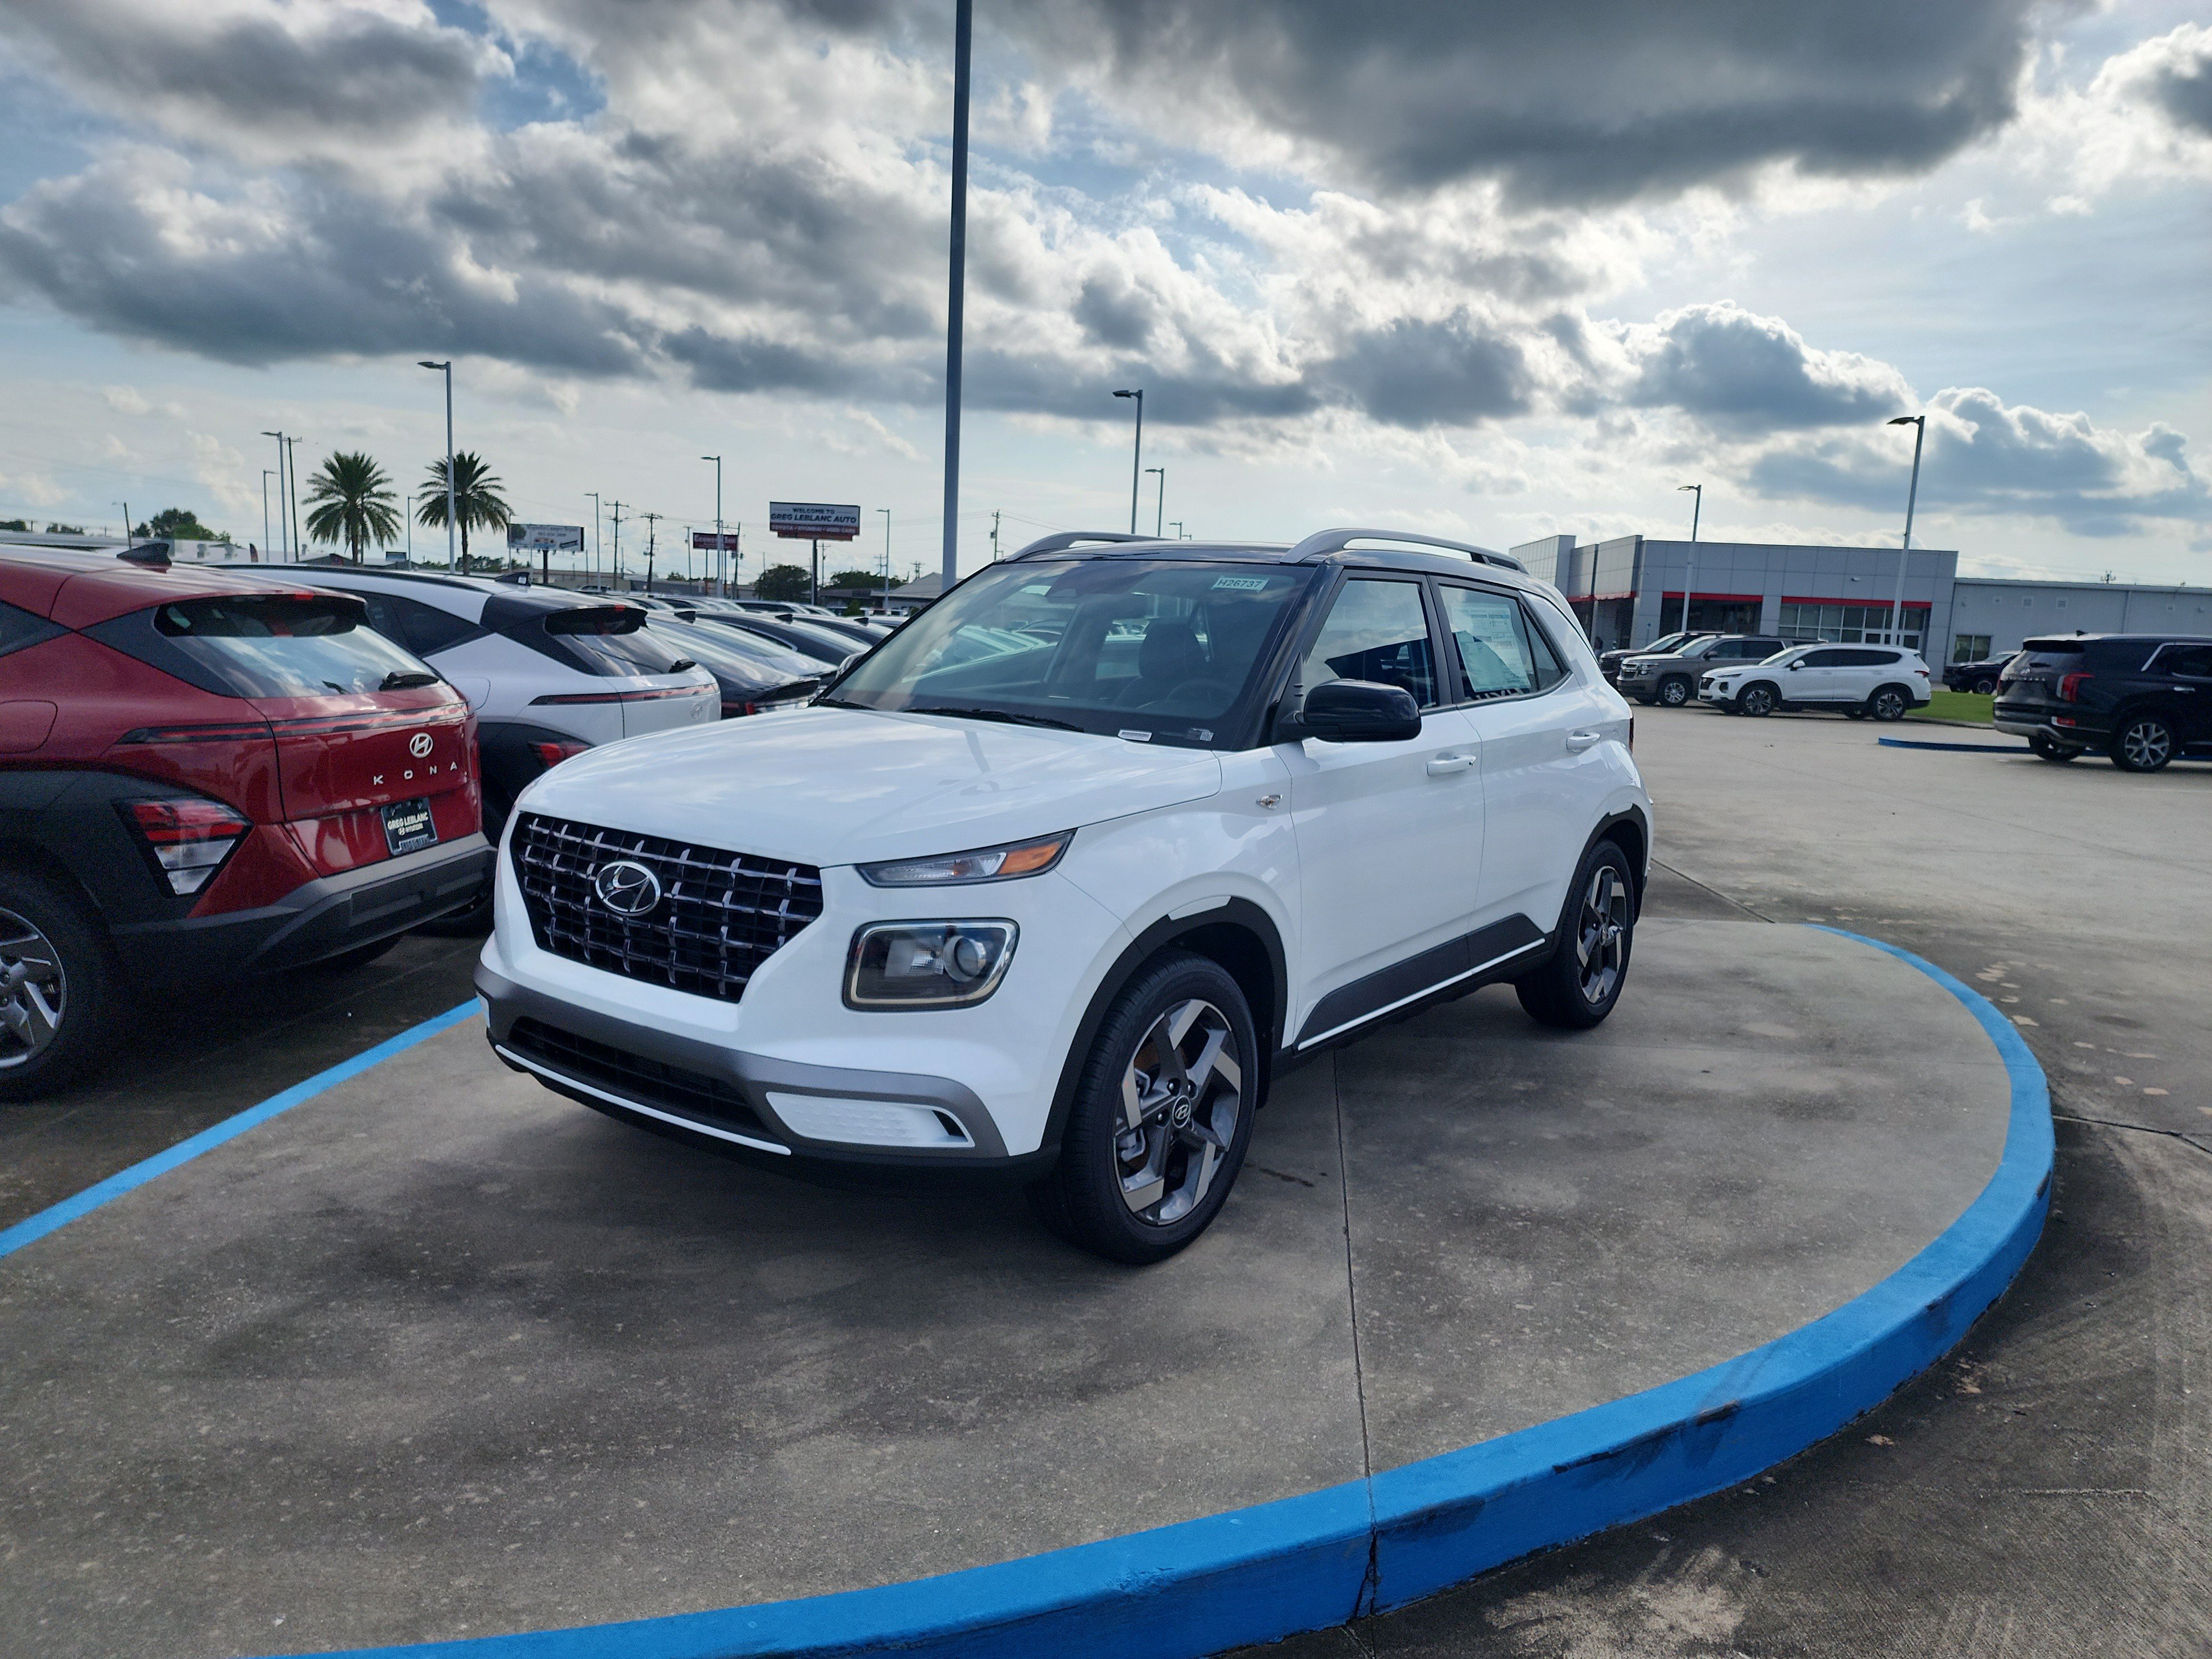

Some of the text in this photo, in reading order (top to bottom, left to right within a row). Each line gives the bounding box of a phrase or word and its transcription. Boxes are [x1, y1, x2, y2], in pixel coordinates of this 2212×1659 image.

[1218, 580, 1262, 588] H26737
[373, 761, 457, 785] KONA
[387, 818, 404, 830] GREG
[404, 811, 429, 826] LEBLANC
